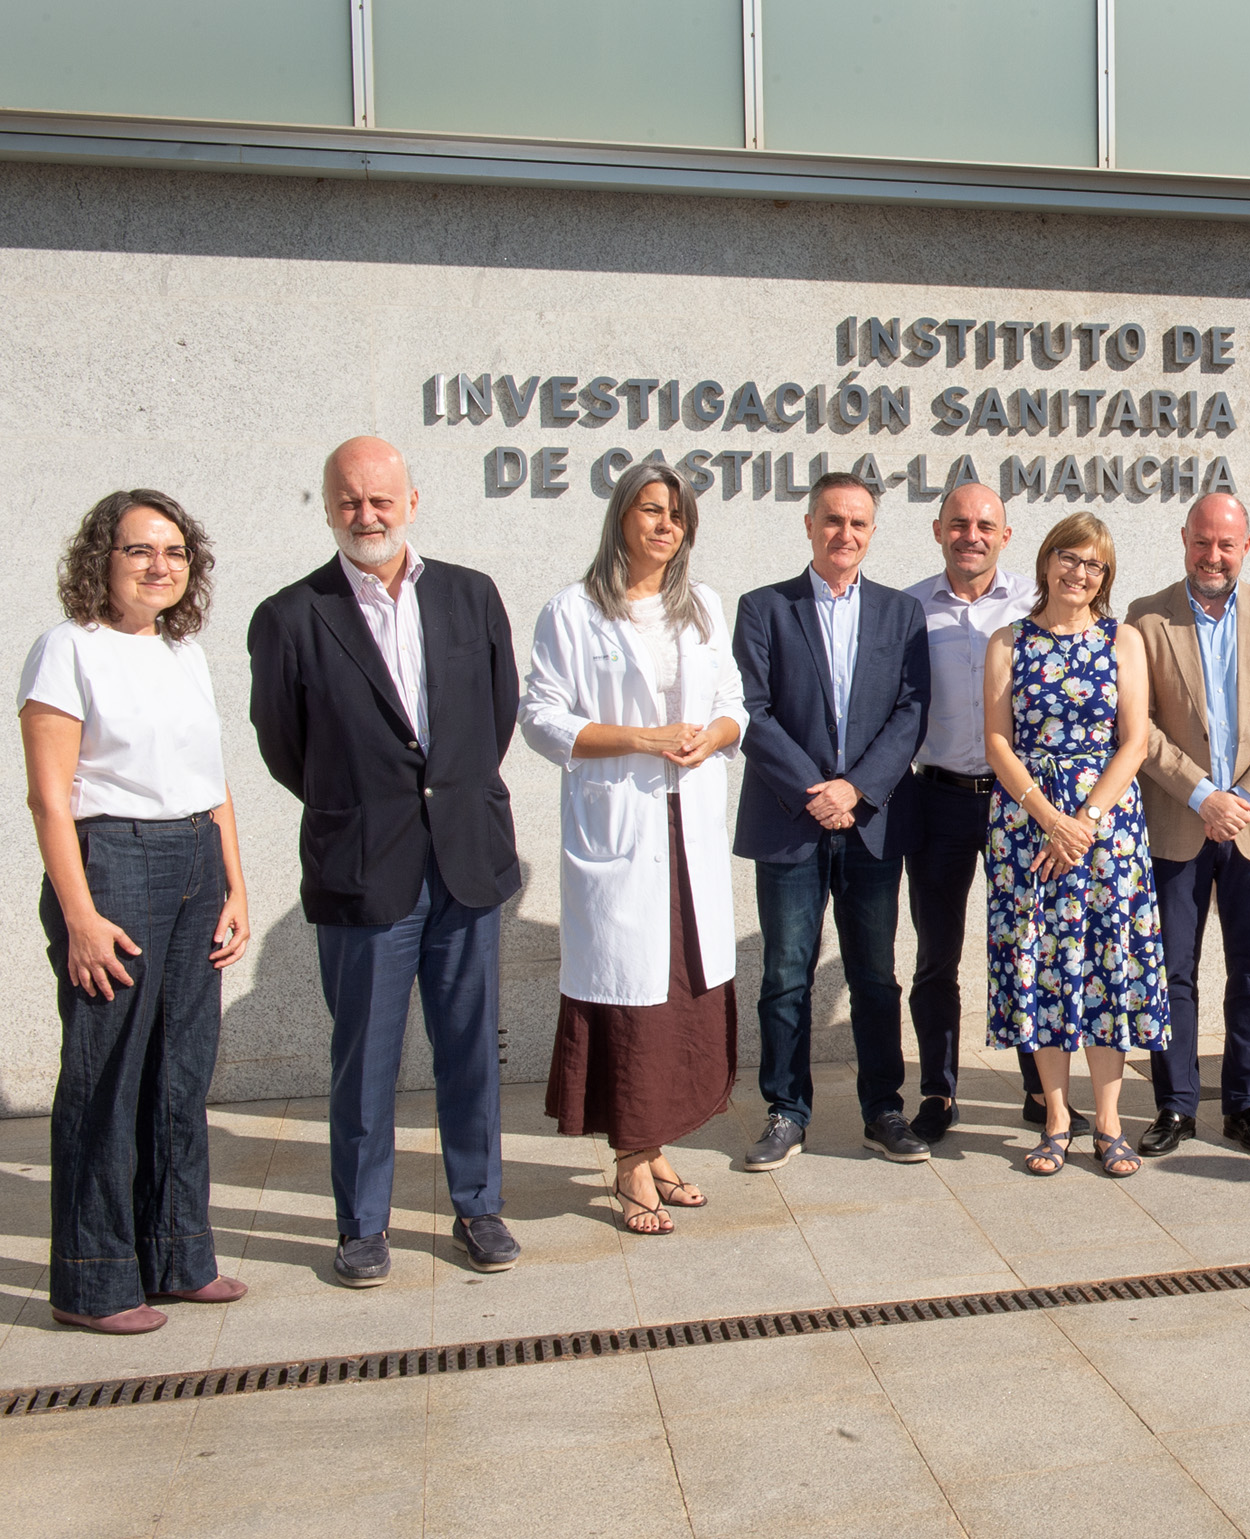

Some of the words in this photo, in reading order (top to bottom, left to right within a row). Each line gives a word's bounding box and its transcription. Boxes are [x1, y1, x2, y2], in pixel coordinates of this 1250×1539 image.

[846, 315, 1146, 364] INSTITUTO
[1175, 325, 1237, 366] DE
[434, 371, 911, 427] INVESTIGACIÓN
[942, 387, 1237, 431] SANITARIA
[495, 446, 570, 490] DE
[1010, 454, 1239, 495] MANCHA
